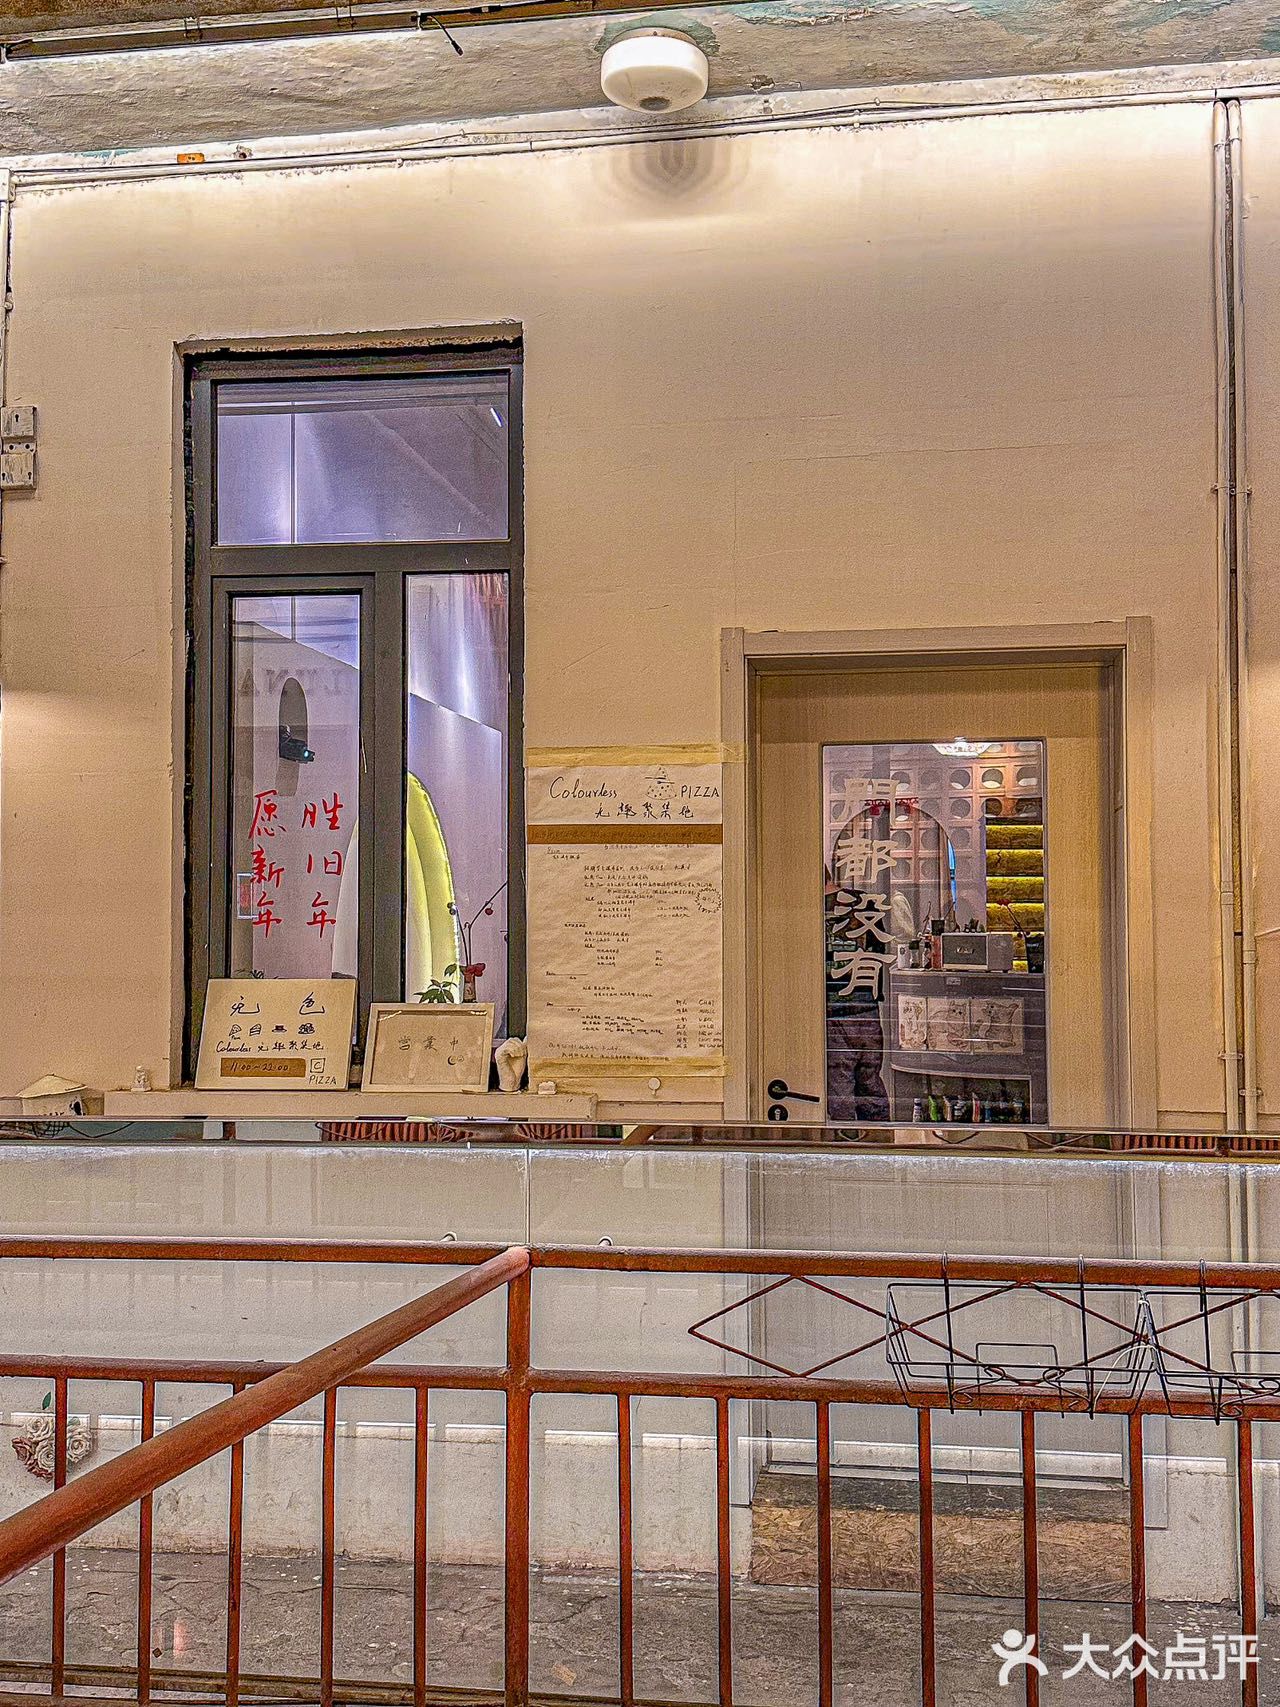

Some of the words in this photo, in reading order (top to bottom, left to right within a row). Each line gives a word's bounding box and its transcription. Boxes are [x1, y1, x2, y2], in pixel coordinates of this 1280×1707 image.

[681, 784, 720, 799] PIZZA
[248, 789, 287, 938] 愿新年
[301, 792, 344, 939] 胜旧年
[309, 1075, 337, 1085] PIZZA
